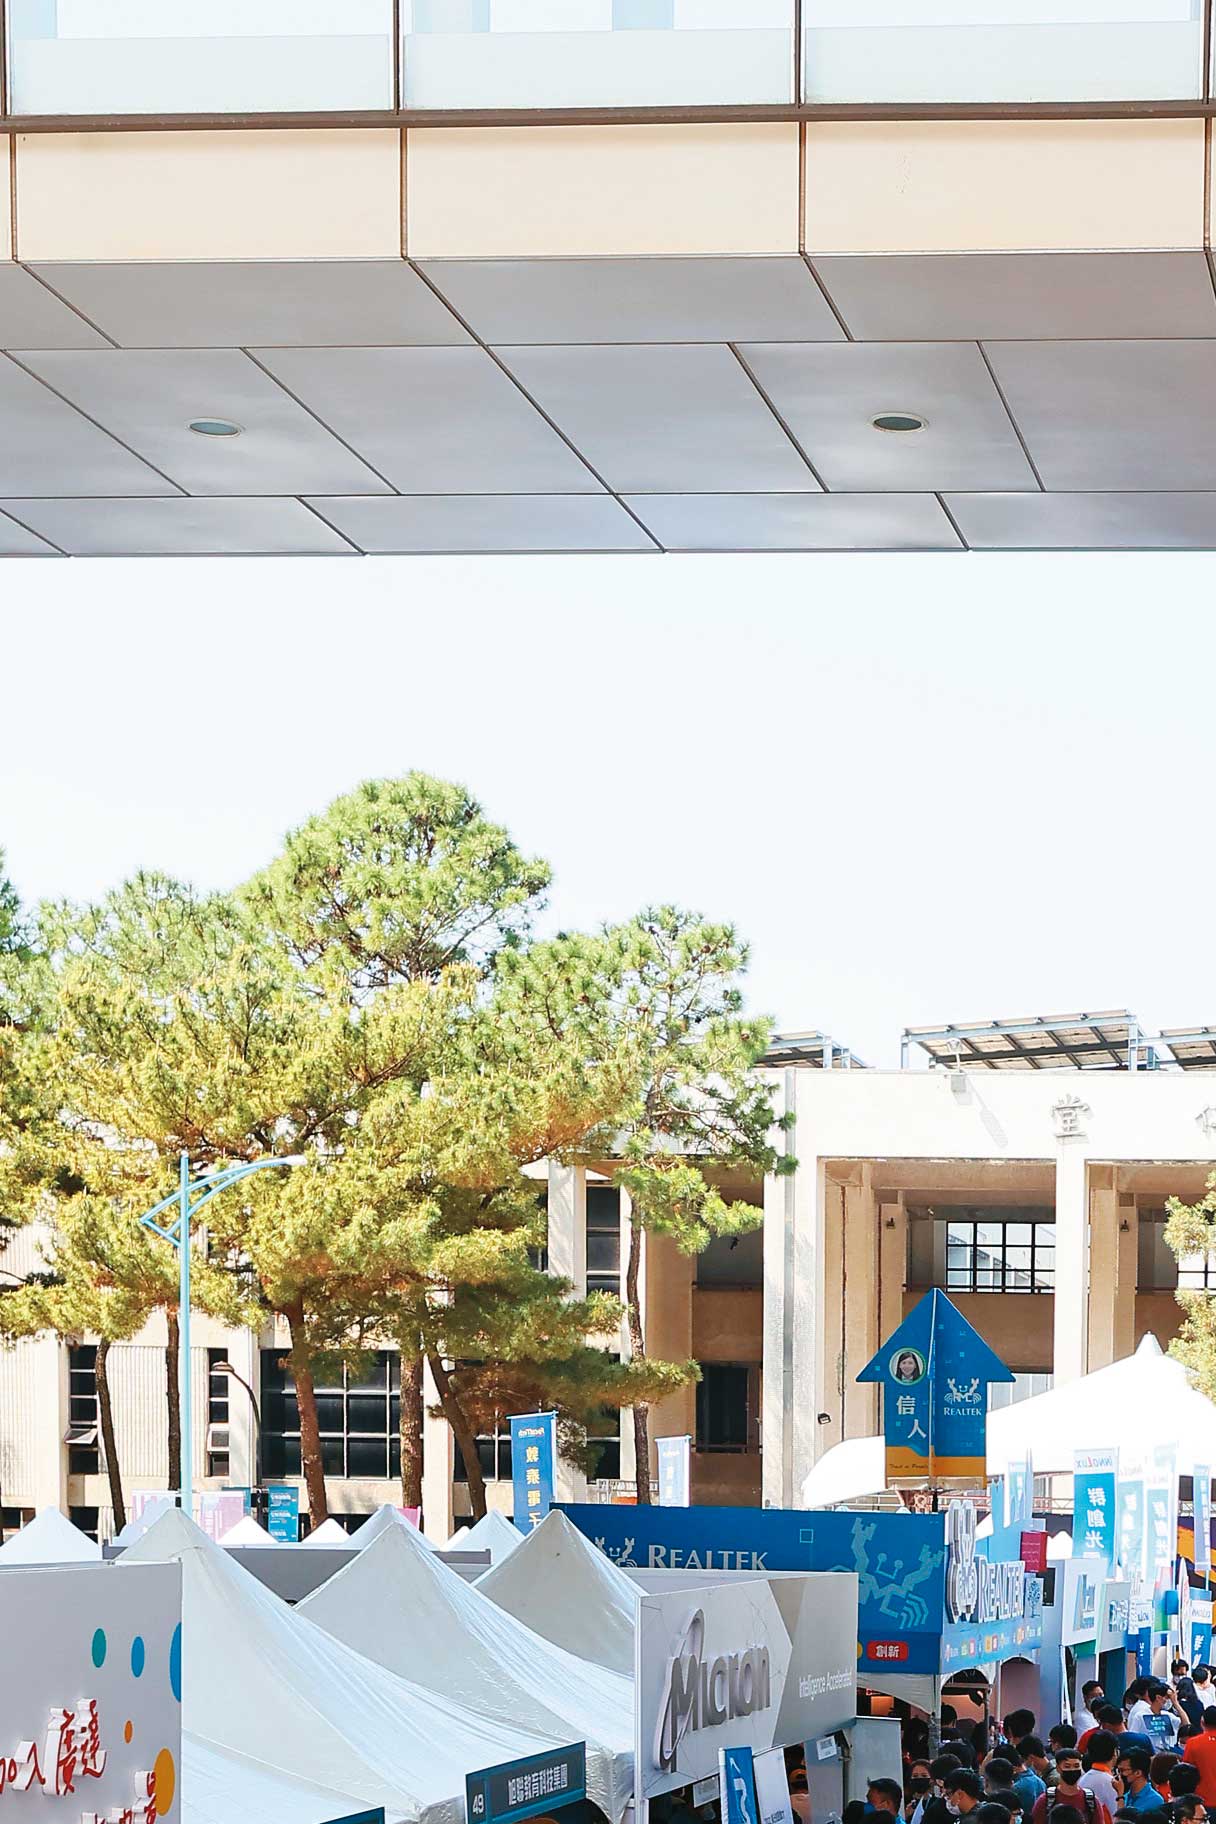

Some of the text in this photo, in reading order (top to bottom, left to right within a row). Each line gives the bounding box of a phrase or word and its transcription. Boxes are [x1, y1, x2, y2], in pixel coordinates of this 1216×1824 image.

[944, 1407, 982, 1416] REALTEK
[648, 1544, 767, 1569] REALTEK
[979, 1555, 1025, 1623] REALTEK
[876, 1645, 900, 1658] 創新
[472, 1794, 485, 1814] 49
